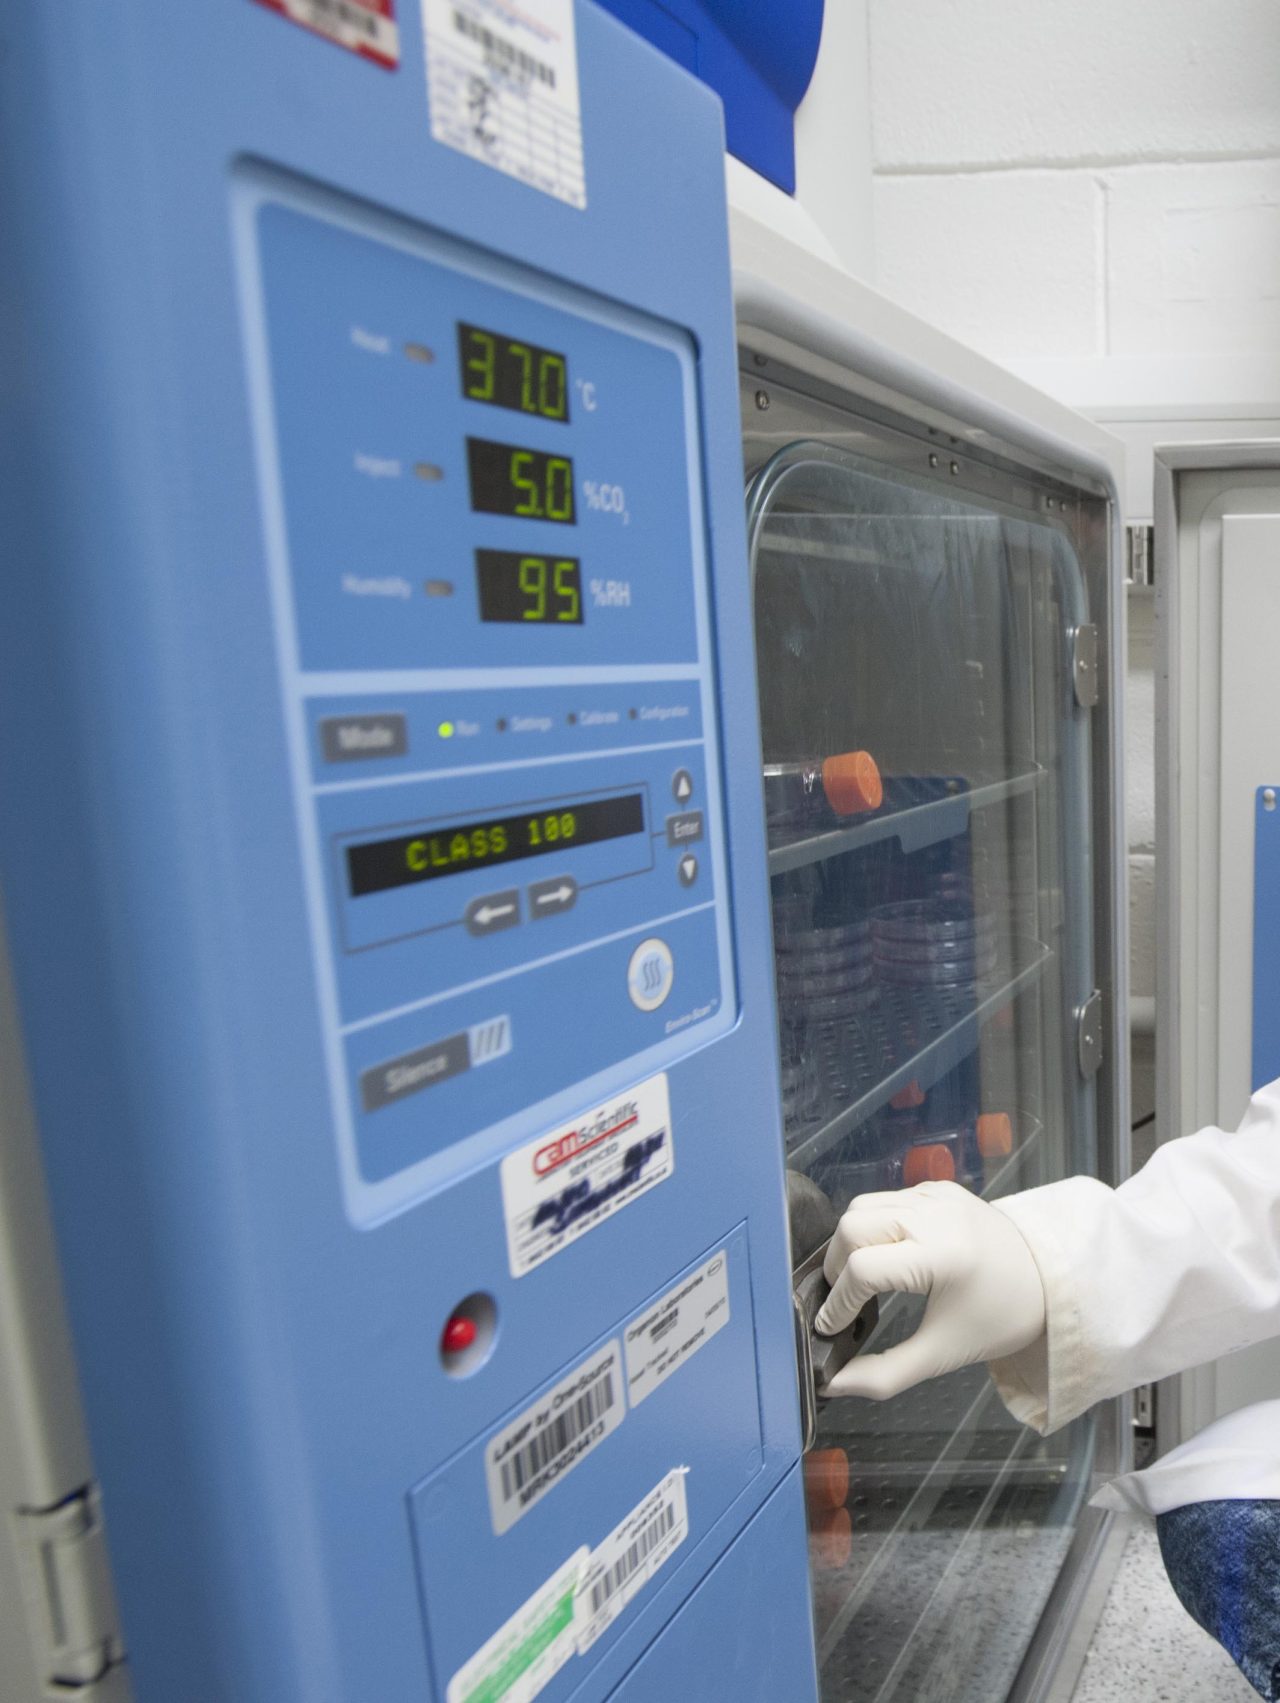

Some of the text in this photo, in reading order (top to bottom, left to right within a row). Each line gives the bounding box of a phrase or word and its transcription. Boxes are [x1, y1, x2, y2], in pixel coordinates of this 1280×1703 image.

[468, 331, 565, 418] 37.0
[511, 452, 573, 520] 5.0
[519, 558, 579, 621] 95
[590, 578, 631, 607] %RH
[338, 724, 393, 749] Mode
[405, 812, 577, 871] CLASS 100
[673, 821, 700, 838] Enter
